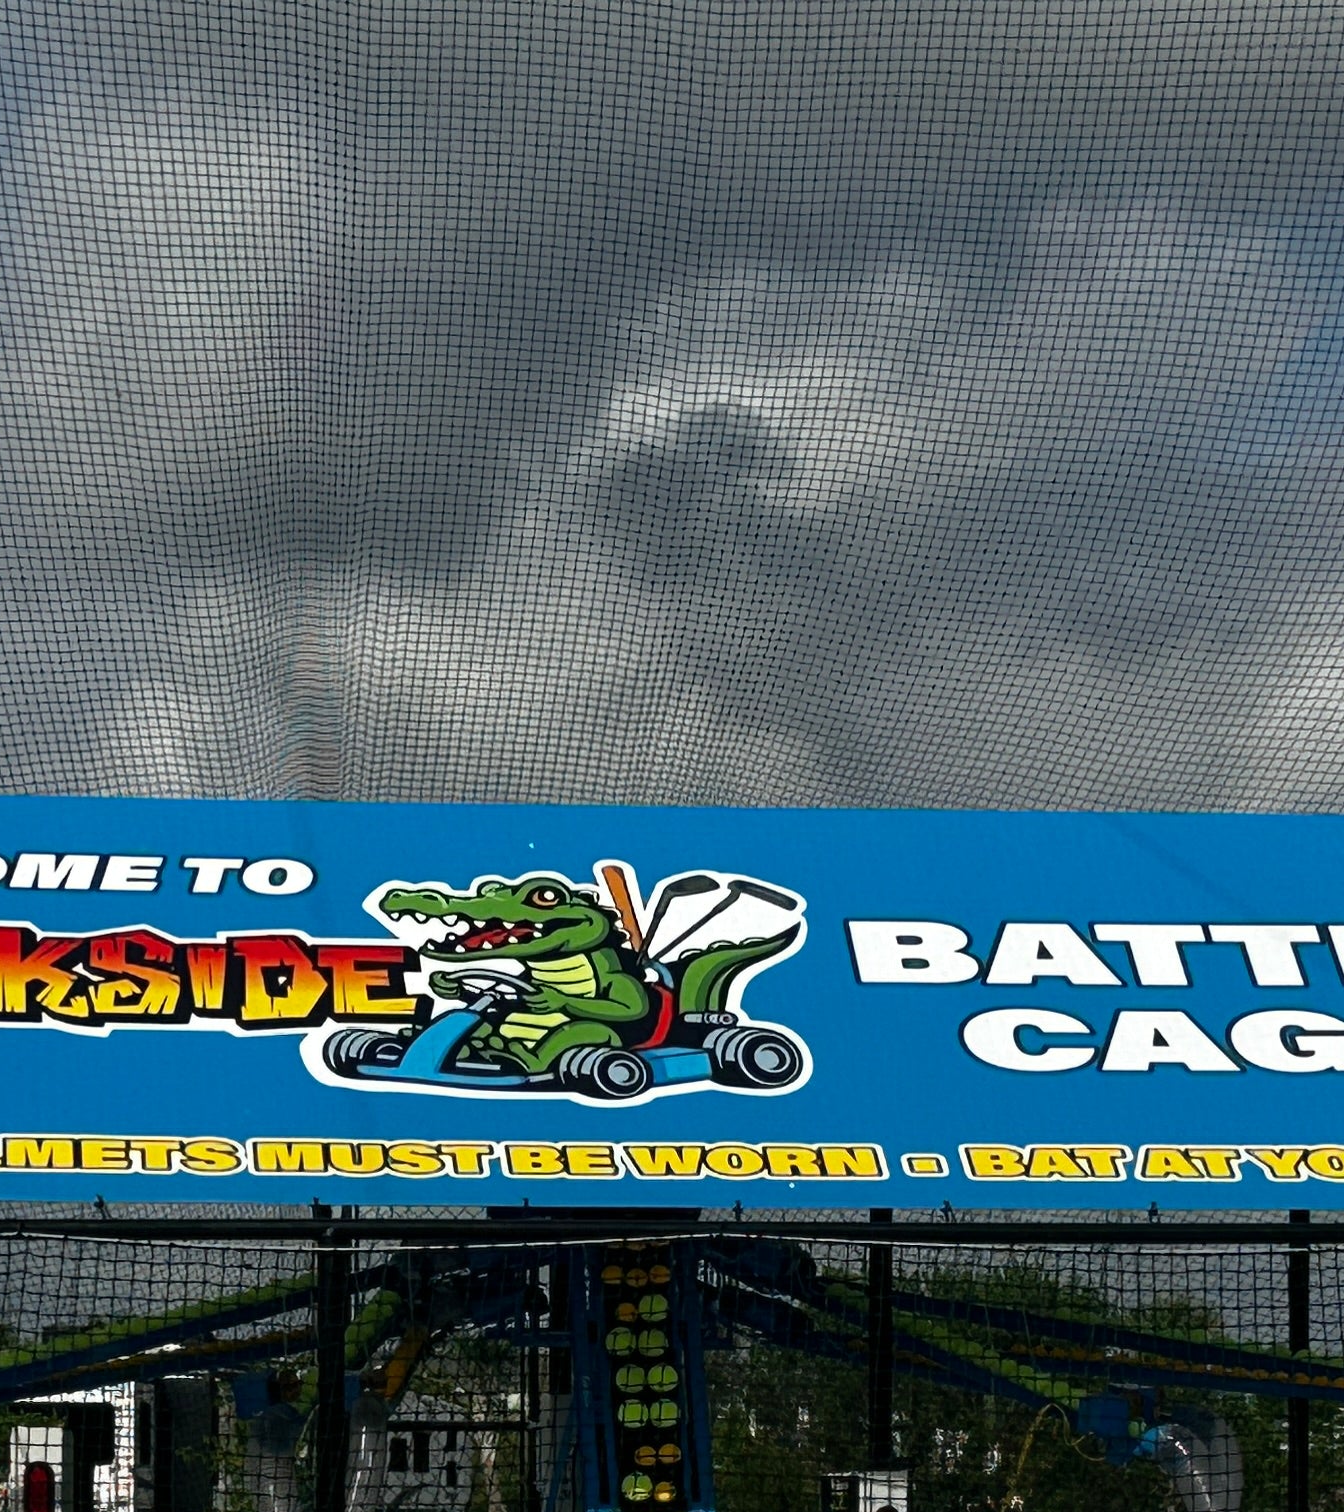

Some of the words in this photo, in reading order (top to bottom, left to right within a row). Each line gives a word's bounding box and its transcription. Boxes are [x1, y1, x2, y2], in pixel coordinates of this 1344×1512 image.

[182, 856, 315, 896] TO
[254, 1139, 484, 1176] MUST
[507, 1142, 613, 1177] BE
[627, 1143, 880, 1178] WORN
[967, 1145, 1122, 1179] BAT
[1143, 1145, 1233, 1178] AT
